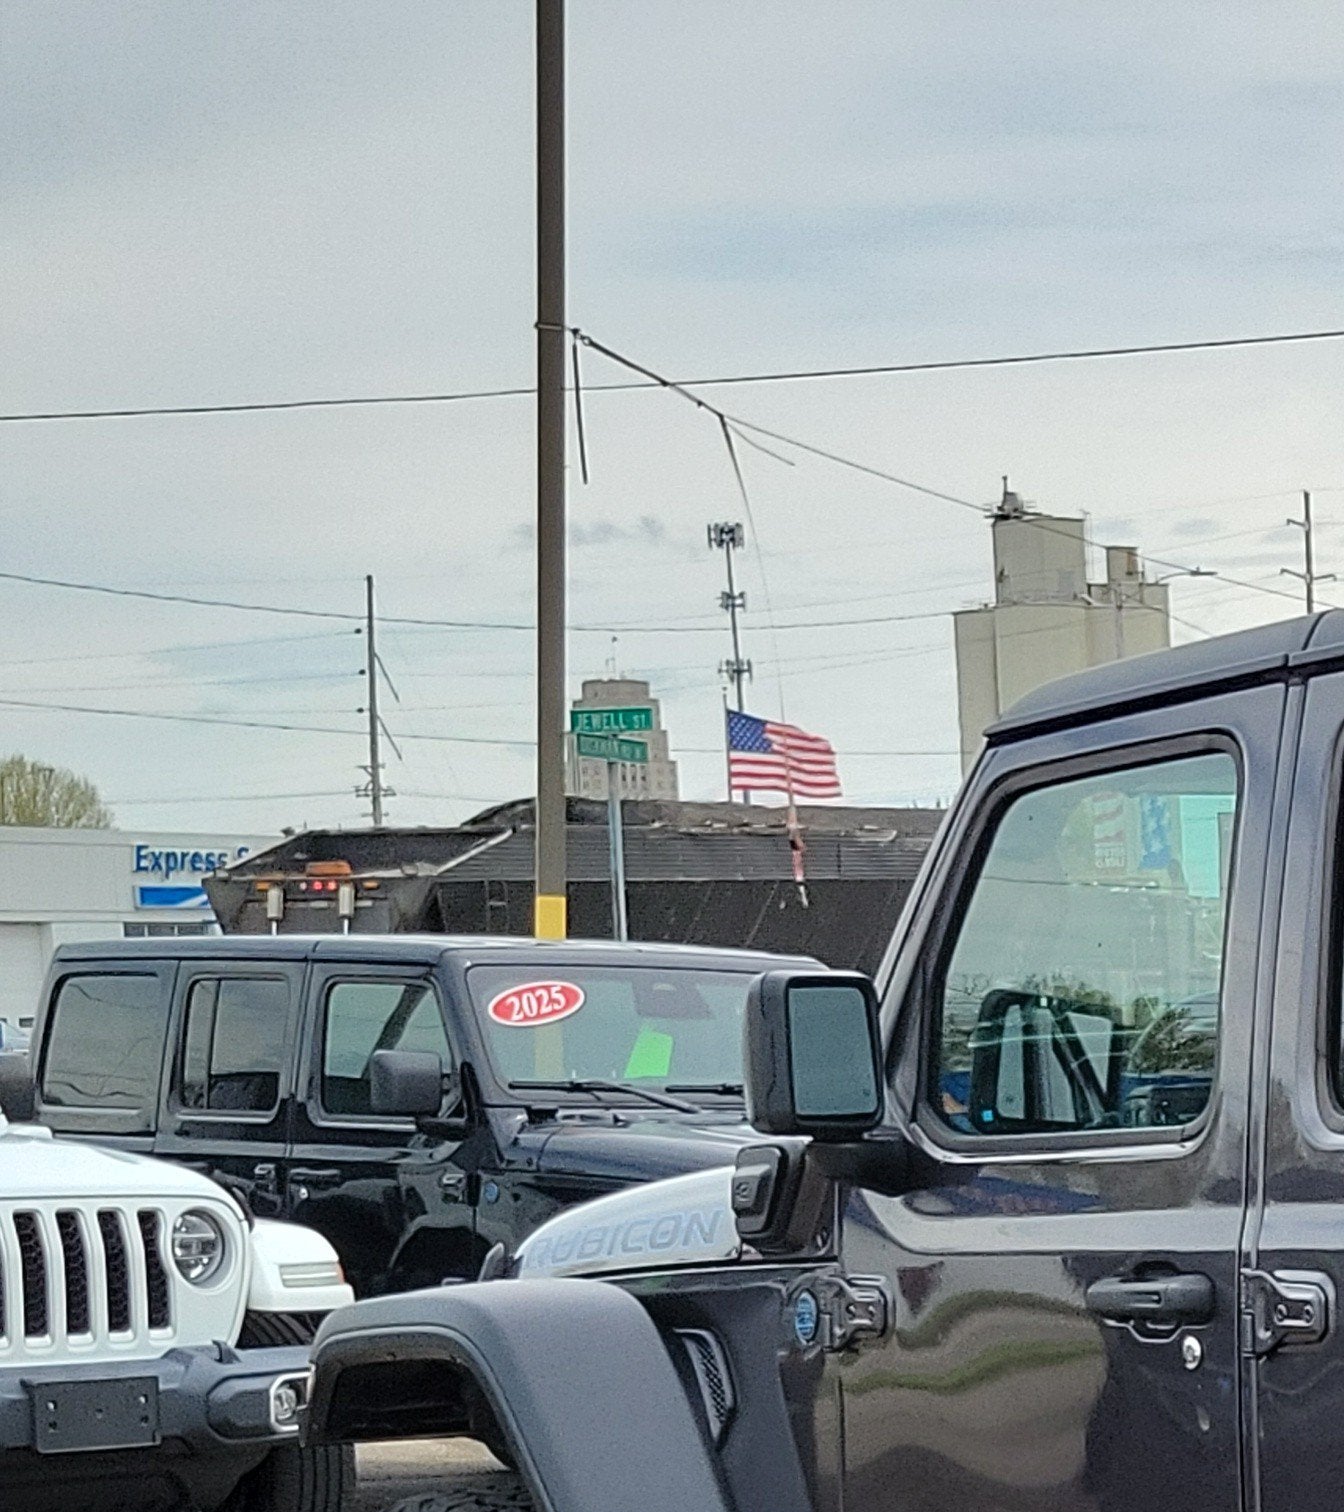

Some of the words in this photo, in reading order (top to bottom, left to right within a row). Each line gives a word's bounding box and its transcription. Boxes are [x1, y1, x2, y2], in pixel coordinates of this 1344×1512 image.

[574, 712, 628, 731] JEWELL
[135, 845, 228, 880] Express
[505, 985, 567, 1021] 2025
[526, 1209, 723, 1269] RUBICON
